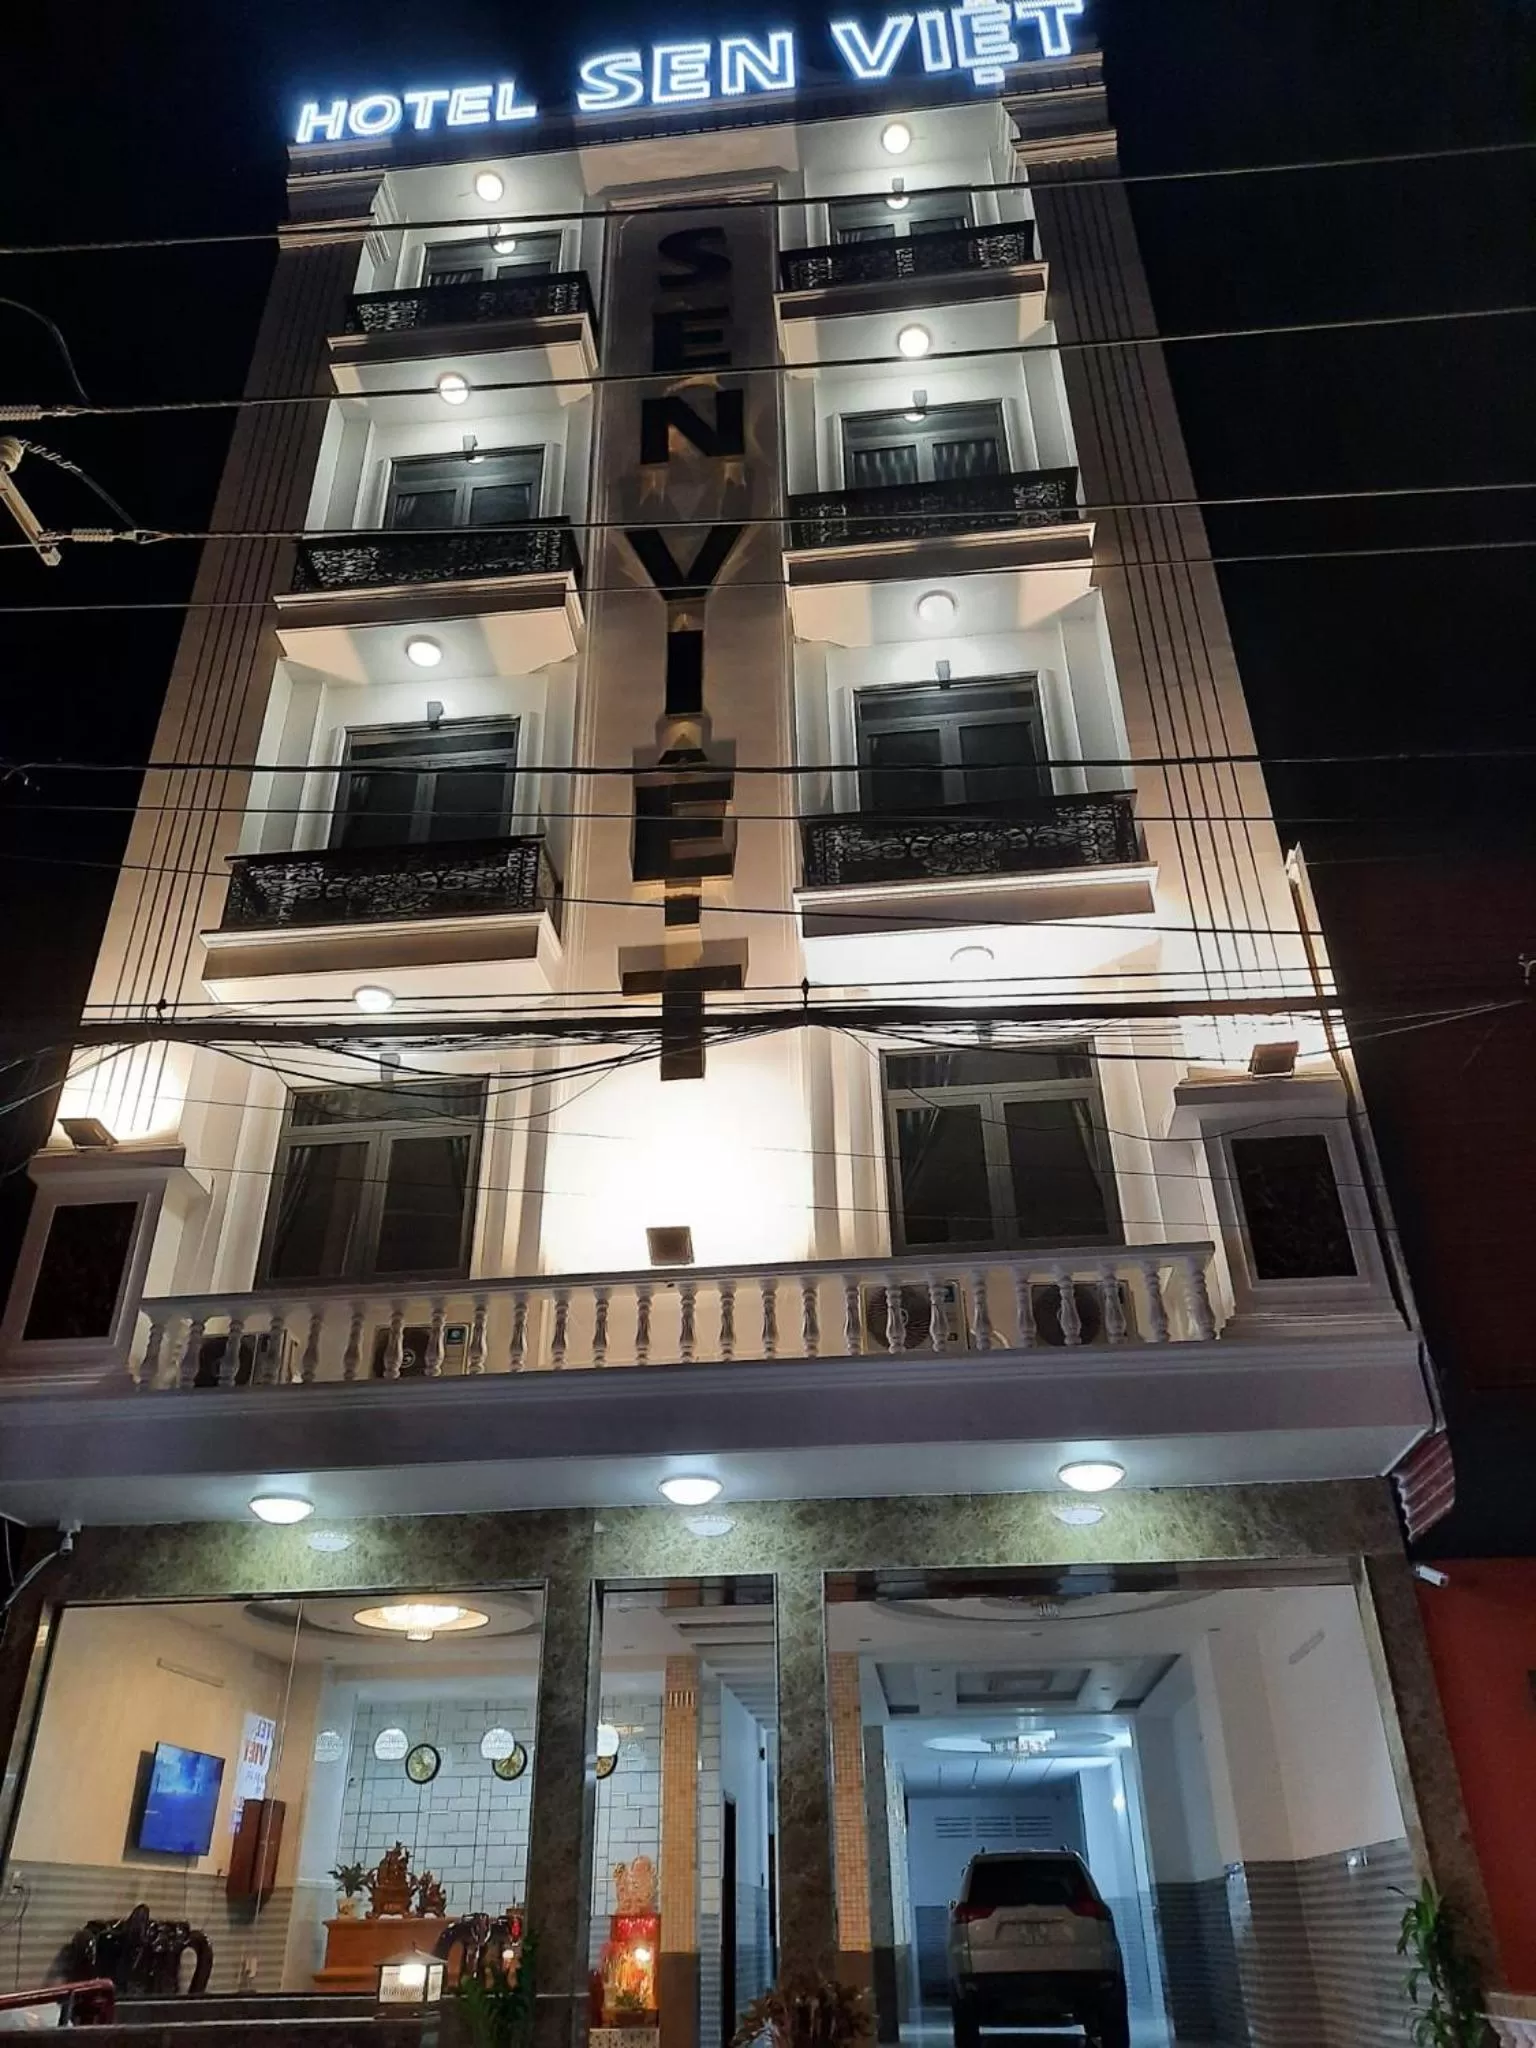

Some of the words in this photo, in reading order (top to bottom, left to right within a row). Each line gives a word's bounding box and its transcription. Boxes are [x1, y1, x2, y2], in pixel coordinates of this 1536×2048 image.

[295, 79, 538, 144] HOTEL
[576, 30, 797, 112] SEN
[829, 0, 1085, 87] VIỆT
[639, 225, 745, 465] SEN
